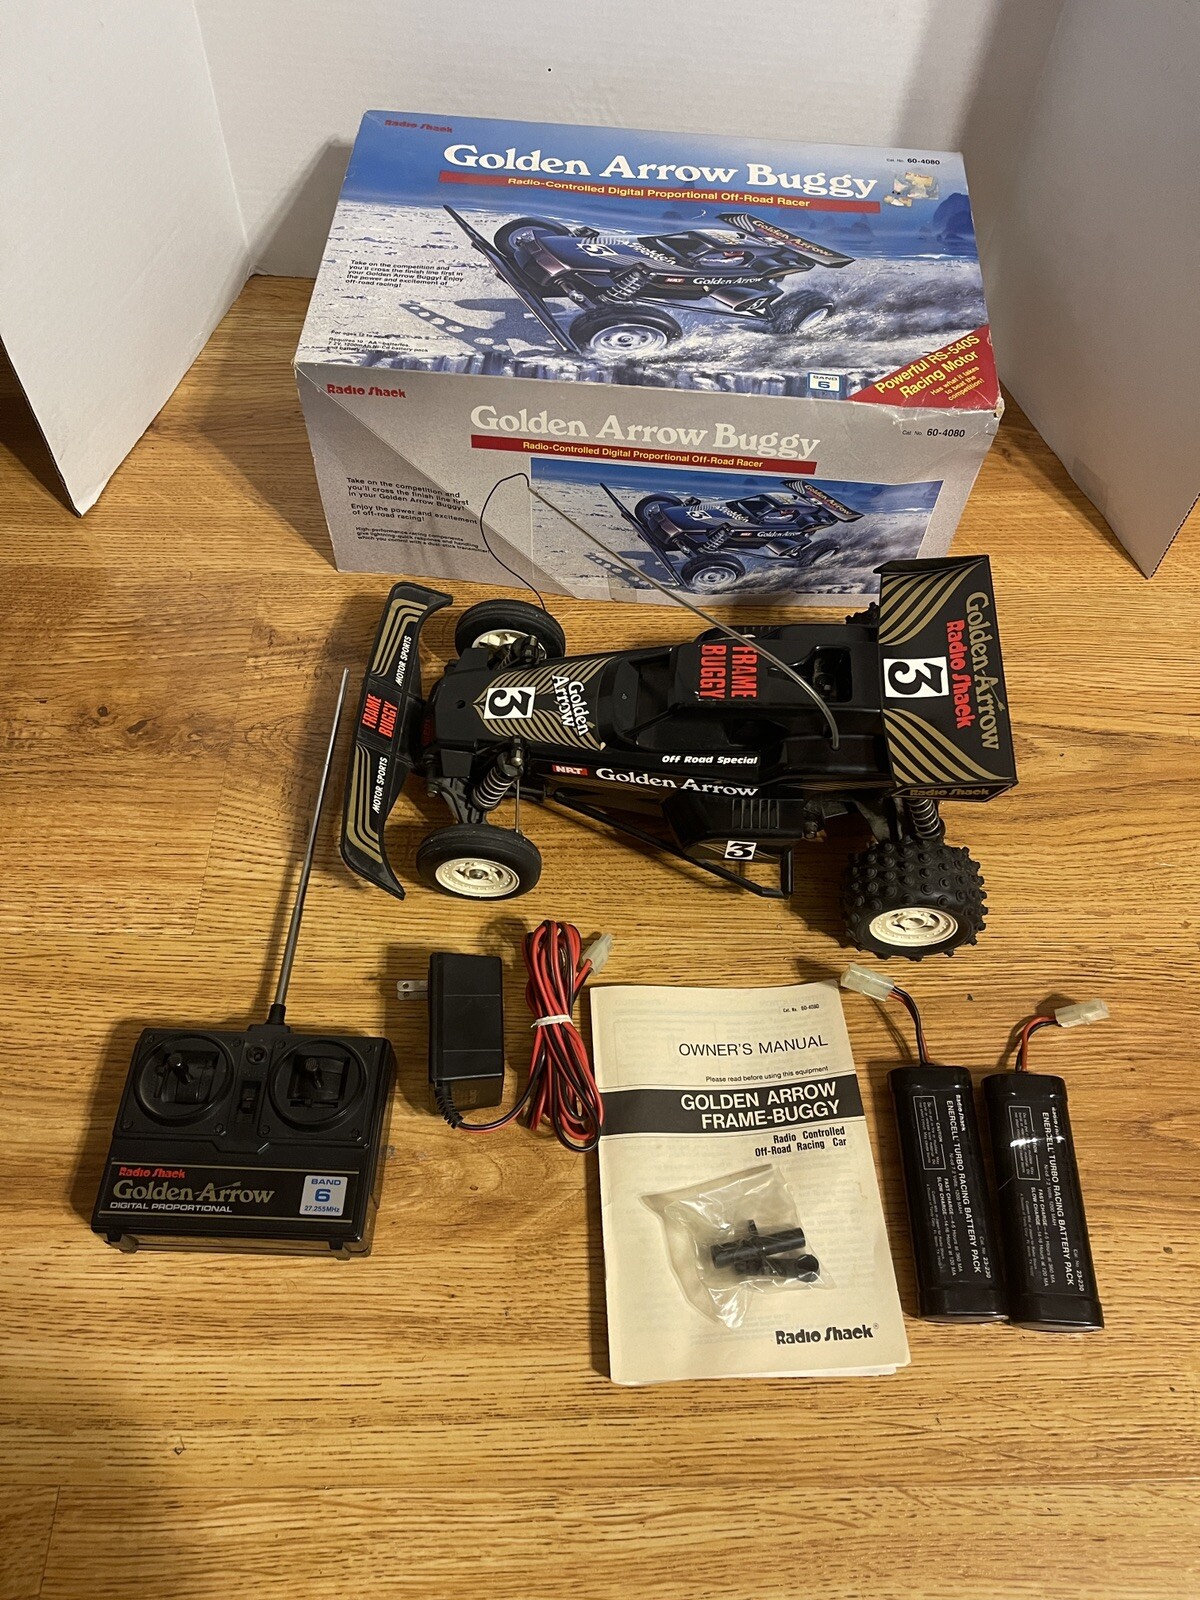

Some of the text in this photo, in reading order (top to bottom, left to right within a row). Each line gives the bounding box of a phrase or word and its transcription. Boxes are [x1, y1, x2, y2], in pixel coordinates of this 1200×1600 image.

[385, 120, 452, 133] Radio Shack
[444, 144, 878, 199] Golden Arrow Buggy
[508, 178, 810, 207] Radio-Controlled Digital Proportional Off-Road Racer
[693, 276, 763, 286] Golden Arrow
[875, 335, 980, 393] Powerful RS-540S
[900, 351, 978, 398] Racing Motor
[327, 384, 406, 398] Radio Shack
[930, 366, 979, 396] Has what takes
[947, 379, 985, 401] competition!
[950, 381, 966, 393] beat
[965, 375, 976, 385] the
[470, 405, 821, 460] Golden Arrow Buggy
[927, 429, 965, 437] 60-4080
[522, 442, 764, 468] Radio-Controlled Digital Proportional Off-Road Racer
[396, 483, 442, 495] competition
[412, 491, 434, 499] finish
[351, 503, 373, 511] Enjoy
[435, 512, 478, 524] excitement
[362, 510, 394, 518] off-road
[397, 514, 425, 522] racing!
[410, 497, 434, 505] Arrow
[437, 501, 465, 511] Buggy!
[395, 636, 412, 686] MOTOR SPORTS
[700, 645, 726, 699] BUGGY
[731, 646, 758, 698] FRAME
[946, 619, 975, 729] Radio Shack
[966, 591, 1000, 750] Golden Arrow
[888, 661, 943, 695] 3
[362, 694, 381, 728] FRAME
[488, 689, 532, 717] 3
[552, 675, 574, 728] Arrow
[568, 680, 589, 736] Golden
[379, 701, 397, 737] BUGGY
[556, 766, 583, 774] NRT
[684, 756, 713, 764] Road
[717, 756, 757, 765] Special
[372, 757, 388, 814] MOTOR SPORTS
[596, 768, 758, 797] Golden Arrow
[949, 788, 990, 796] Shack
[728, 843, 755, 858] 3
[679, 1035, 828, 1057] OWNER'S MANUAL
[783, 1069, 794, 1077] this
[795, 1066, 828, 1075] equipment
[681, 1082, 836, 1111] GOLDEN ARROW
[701, 1100, 840, 1130] FRAME-BUGGY
[955, 1094, 968, 1132] Radio Shack
[754, 1138, 847, 1157] Off-Road Racing Car
[773, 1126, 845, 1144] Radio Controlled
[953, 1143, 964, 1171] TURBO
[1048, 1154, 1059, 1183] TURBO
[119, 1166, 185, 1179] Radio Shack
[311, 1178, 342, 1186] BAND
[113, 1180, 275, 1203] Golden Arrow
[314, 1188, 331, 1202] 6
[958, 1173, 970, 1206] RACING
[1052, 1184, 1064, 1217] RACING
[110, 1202, 232, 1213] DIGITAL PROPORTIONAL
[304, 1205, 340, 1213] 27.255MHz
[963, 1207, 976, 1248] BATTERY
[1057, 1218, 1070, 1260] BATTERY
[970, 1248, 981, 1274] PACK
[982, 1256, 991, 1278] 23-230
[1063, 1261, 1074, 1286] PACK
[1075, 1269, 1085, 1292] 23-230
[775, 1324, 874, 1345] Radio Shack
